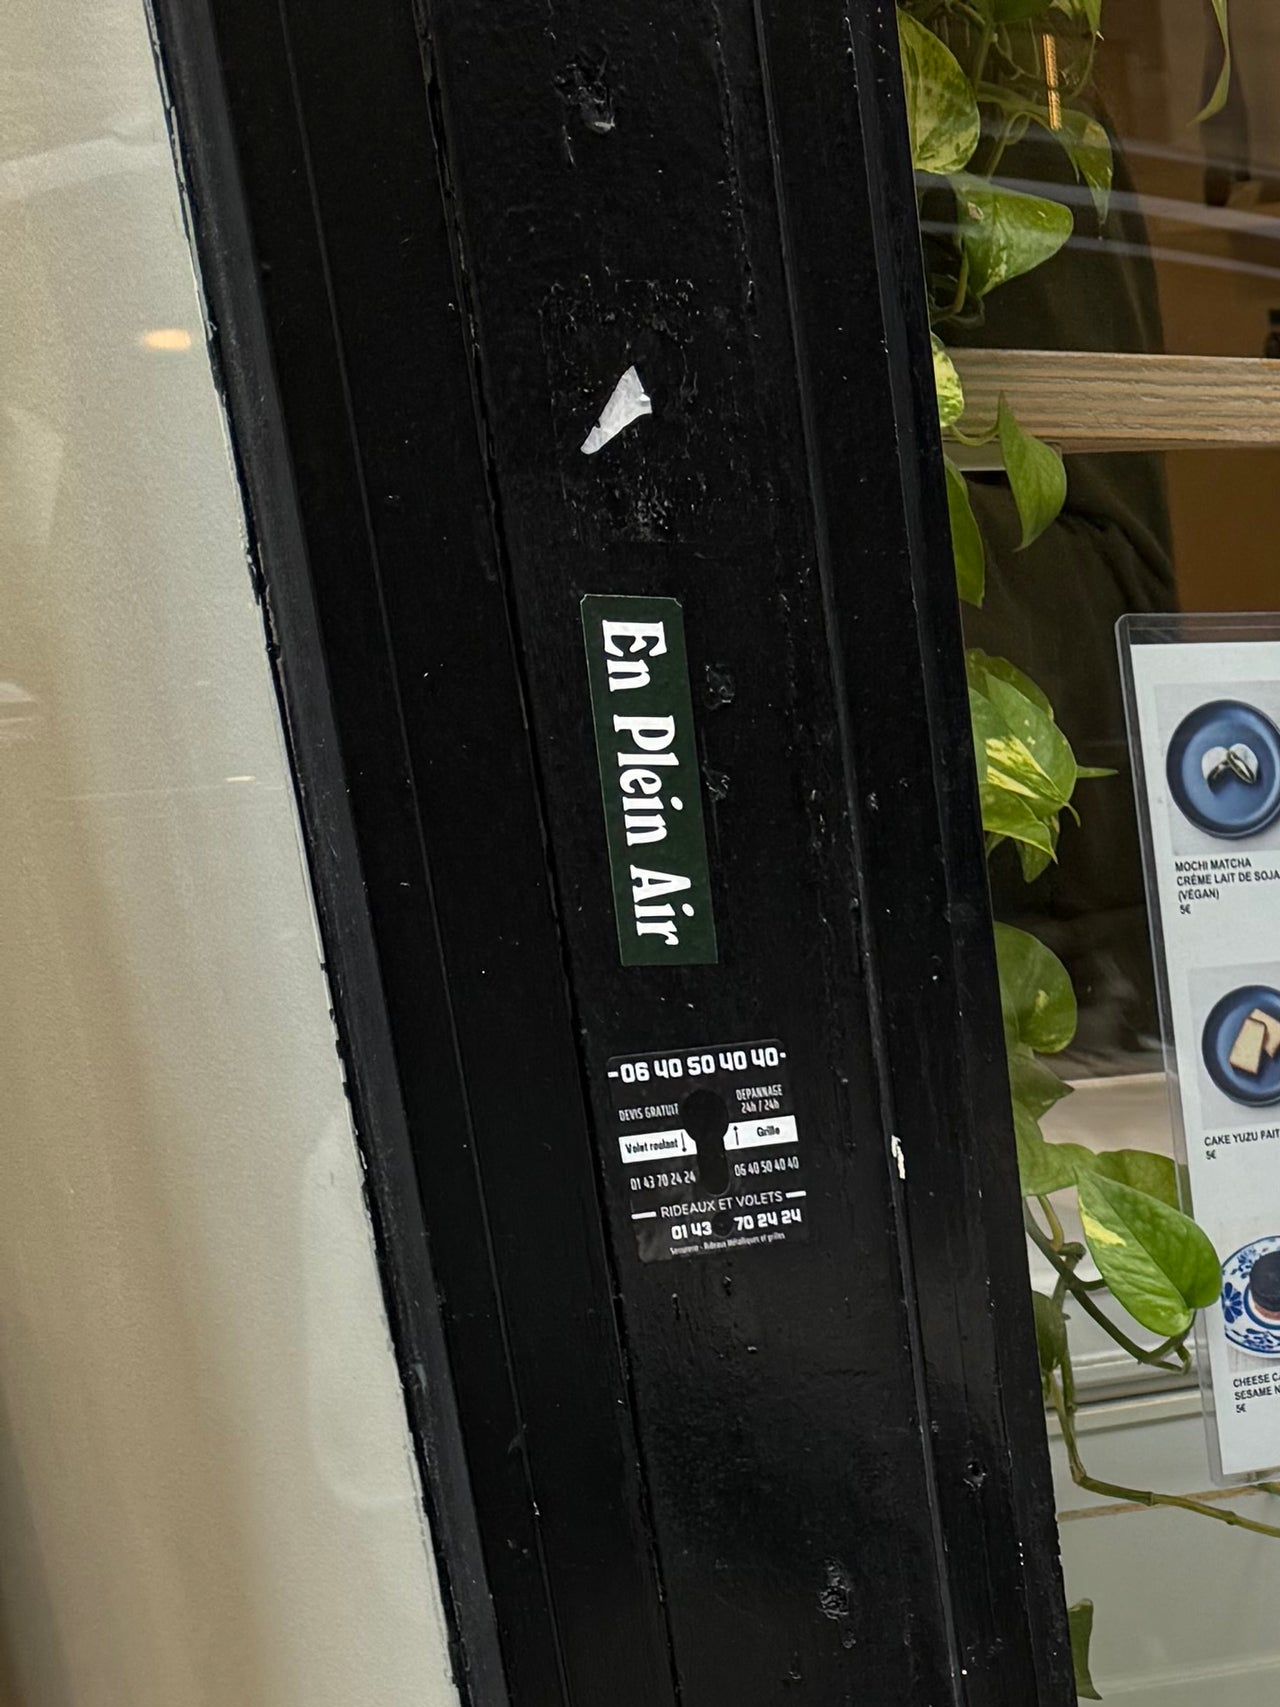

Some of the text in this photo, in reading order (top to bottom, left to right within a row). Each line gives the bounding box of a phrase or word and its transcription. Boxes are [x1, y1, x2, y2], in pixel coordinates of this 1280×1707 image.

[601, 619, 695, 946] En Plein Air
[1174, 857, 1252, 872] MOCHI MATCHA
[1213, 872, 1236, 884] LAIT
[1238, 871, 1252, 882] DE
[1254, 869, 1280, 881] SOJA
[1178, 888, 1220, 903] (VÉGAN)
[1179, 904, 1192, 915] 5€
[653, 1058, 684, 1078] 40
[686, 1054, 716, 1076] 50
[718, 1050, 748, 1071] 40
[619, 1103, 679, 1121] DEVIS GRATUIT
[741, 1101, 757, 1114] 24h
[763, 1098, 780, 1111] 24h
[756, 1125, 780, 1137] Grille
[1204, 1135, 1232, 1147] CAKE
[1232, 1131, 1259, 1143] YUZU
[625, 1138, 679, 1154] Volet roulant
[748, 1161, 760, 1175] 40
[760, 1160, 773, 1173] 50
[774, 1158, 786, 1171] 40
[787, 1156, 800, 1169] 40
[630, 1170, 697, 1191] 01 43 70 24 24
[660, 1190, 784, 1219] RIDEAUX ET VOLETS
[671, 1208, 803, 1240] 01 43 70 24 24
[1232, 1373, 1271, 1388] CHEESE
